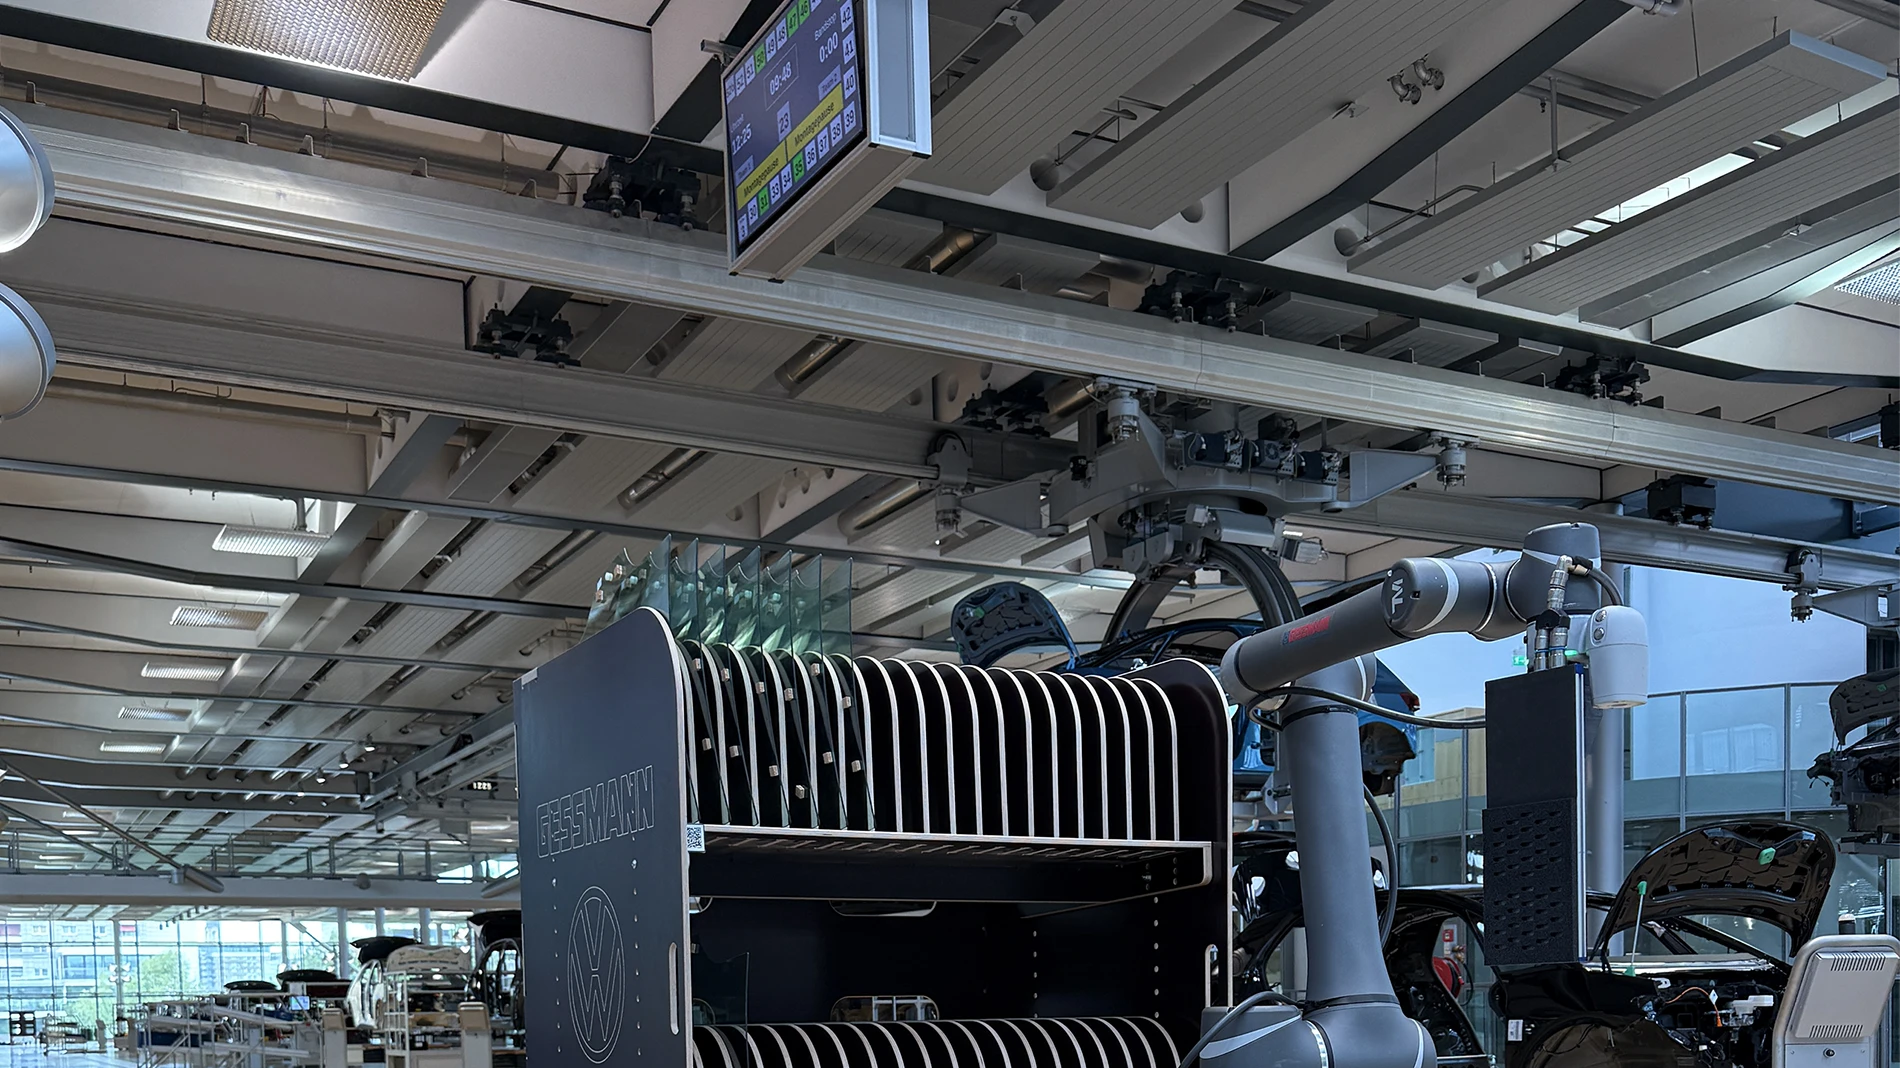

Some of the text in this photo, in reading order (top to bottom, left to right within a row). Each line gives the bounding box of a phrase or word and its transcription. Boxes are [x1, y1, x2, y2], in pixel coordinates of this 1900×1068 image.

[789, 13, 797, 29] 47
[842, 6, 851, 23] 42
[820, 31, 838, 63] 0:00
[845, 40, 853, 56] 41
[769, 61, 791, 96] 09:48
[846, 74, 853, 92] 40
[779, 112, 789, 133] 23
[794, 102, 834, 147] Montagepause
[732, 123, 752, 155] 12:25
[783, 171, 790, 187] 34
[795, 159, 803, 177] 35
[807, 147, 815, 165] 36
[820, 135, 827, 153] 37
[832, 123, 840, 140] 38
[846, 109, 854, 128] 39
[743, 157, 779, 198] Montagepause
[536, 765, 654, 858] GESSMANN
